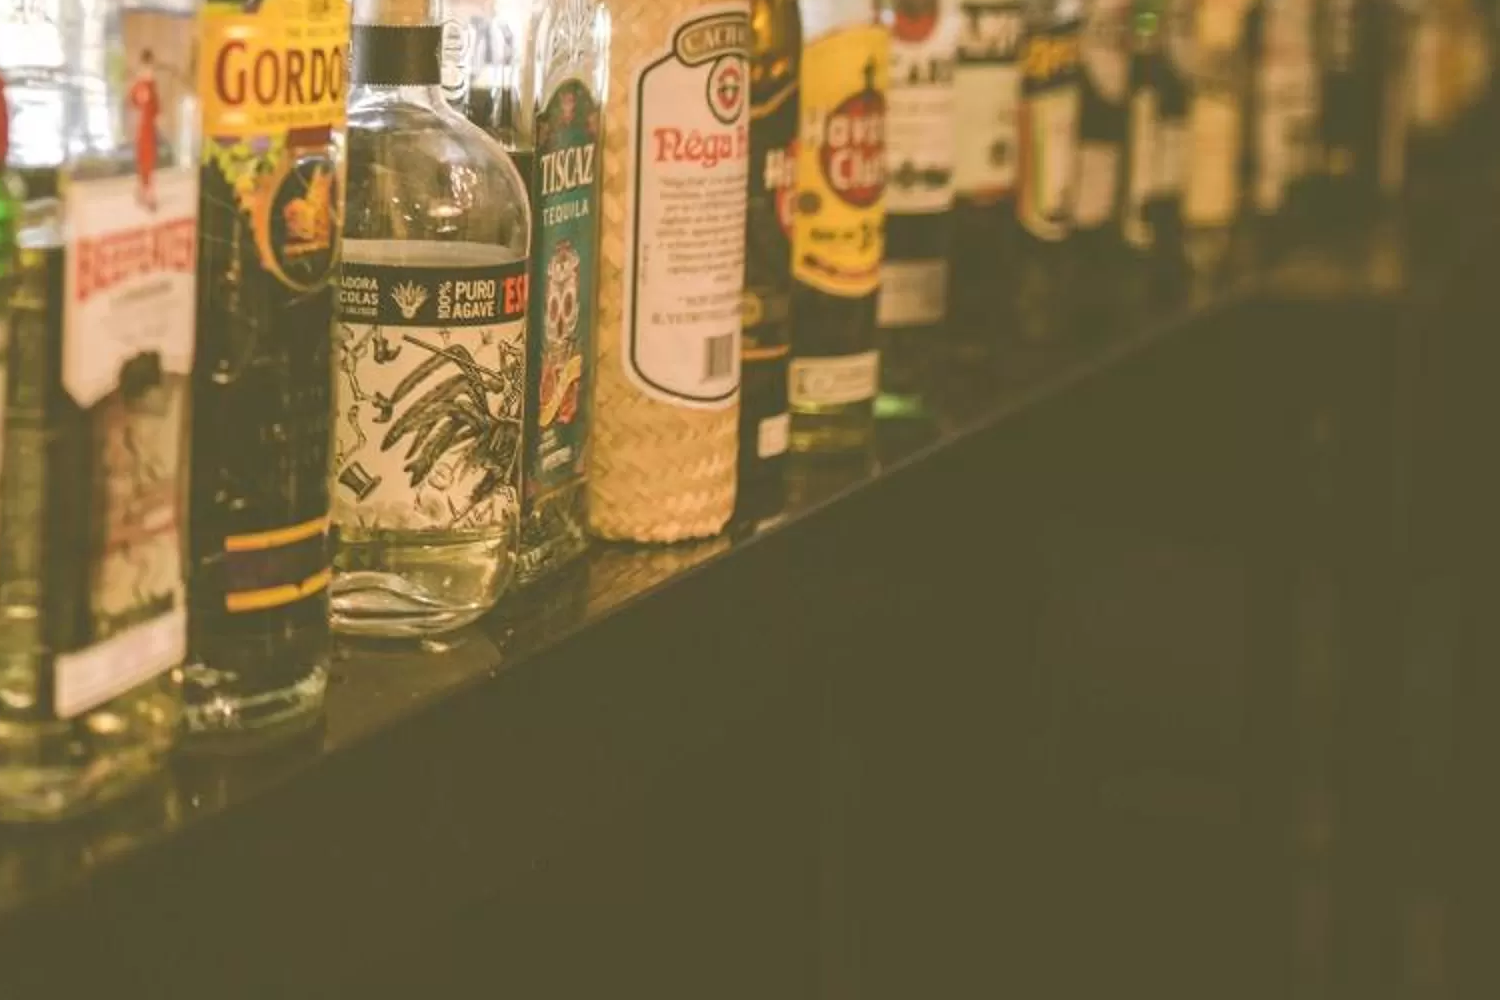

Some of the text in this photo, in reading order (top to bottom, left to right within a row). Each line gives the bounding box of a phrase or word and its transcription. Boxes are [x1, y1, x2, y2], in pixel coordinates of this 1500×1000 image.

[541, 143, 596, 196] TISCAZ
[543, 197, 590, 227] TEQUILA
[455, 278, 496, 302] PURO
[452, 300, 495, 320] AGAVE
